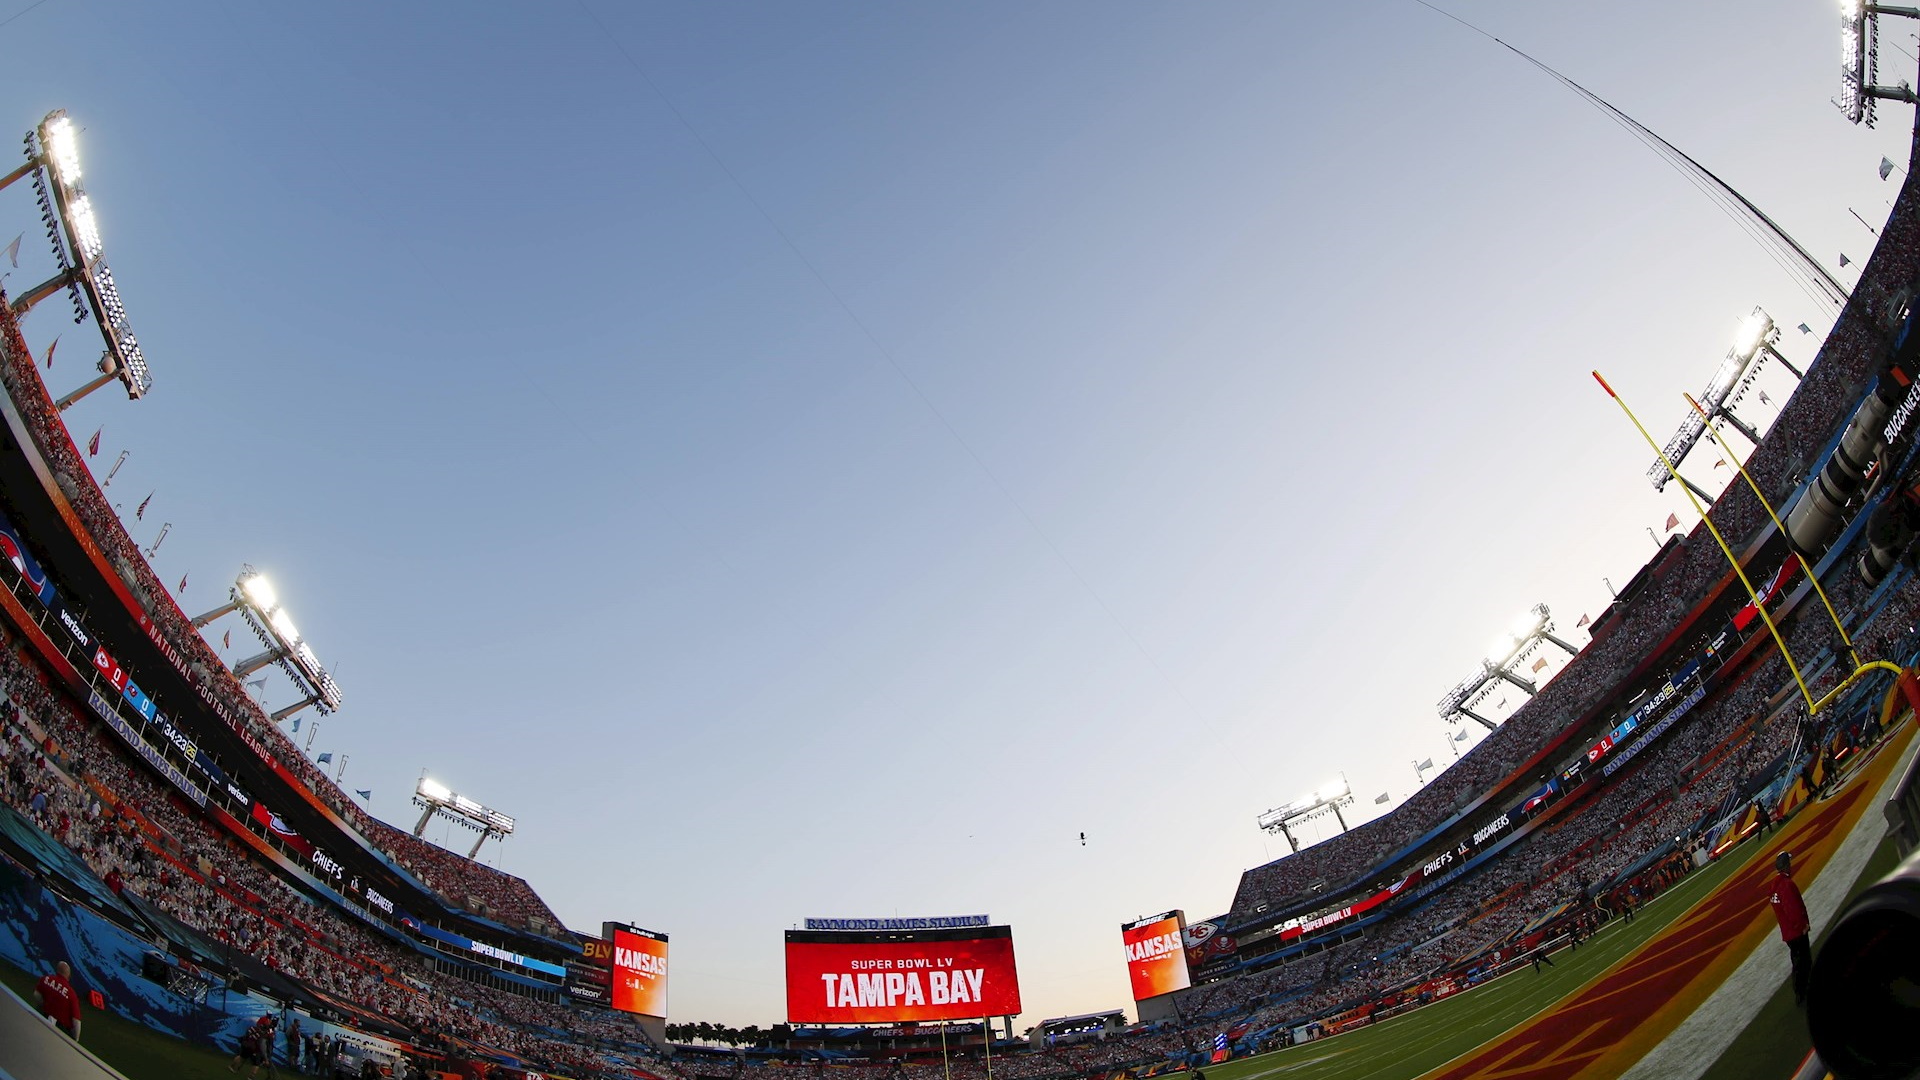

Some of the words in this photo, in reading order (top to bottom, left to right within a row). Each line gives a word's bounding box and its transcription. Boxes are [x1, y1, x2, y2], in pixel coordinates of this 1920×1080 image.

[60, 609, 88, 646] verizon
[113, 668, 122, 682] 0
[142, 698, 149, 711] 0
[149, 625, 192, 682] NATIONAL
[196, 682, 237, 732] FOOTBALL
[240, 728, 270, 762] LEAGUE
[1644, 692, 1666, 714] 34:23
[164, 724, 188, 751] 34:23
[1604, 741, 1644, 777] RAYMOND
[1642, 721, 1669, 748] JAMES
[1670, 688, 1706, 722] STADIUM
[1624, 720, 1630, 730] 0
[92, 692, 140, 747] RAYMOND
[138, 745, 170, 774] JAMES
[170, 770, 208, 806] STADIUM
[1601, 740, 1608, 750] 0
[228, 783, 248, 806] verizon
[1472, 814, 1510, 845] BUCCANEERS
[312, 850, 342, 880] CHIEFS
[1424, 850, 1453, 876] CHIEFS
[1418, 883, 1437, 898] SUPER
[1438, 872, 1458, 886] BOWL
[366, 888, 394, 914] BUCCANEERS
[807, 918, 878, 930] RAYMOND
[880, 918, 926, 929] JAMES
[928, 916, 988, 927] STADIUM
[1302, 917, 1323, 933] SUPER
[1324, 911, 1342, 927] BOWL
[1342, 907, 1352, 918] LV
[471, 940, 494, 958] SUPER
[494, 948, 515, 963] BOWL
[515, 955, 524, 966] LV
[1125, 931, 1182, 962] KANSAS
[616, 946, 666, 976] KANSAS
[852, 960, 892, 970] SUPER
[897, 958, 933, 968] BOWL
[937, 958, 952, 967] LV
[44, 976, 68, 999] S.A.F.E.
[570, 986, 600, 998] verizon
[821, 972, 925, 1008] TAMPA
[929, 968, 984, 1005] BAY
[872, 1029, 904, 1037] CHIEFS
[914, 1025, 973, 1036] BUCCANEERS
